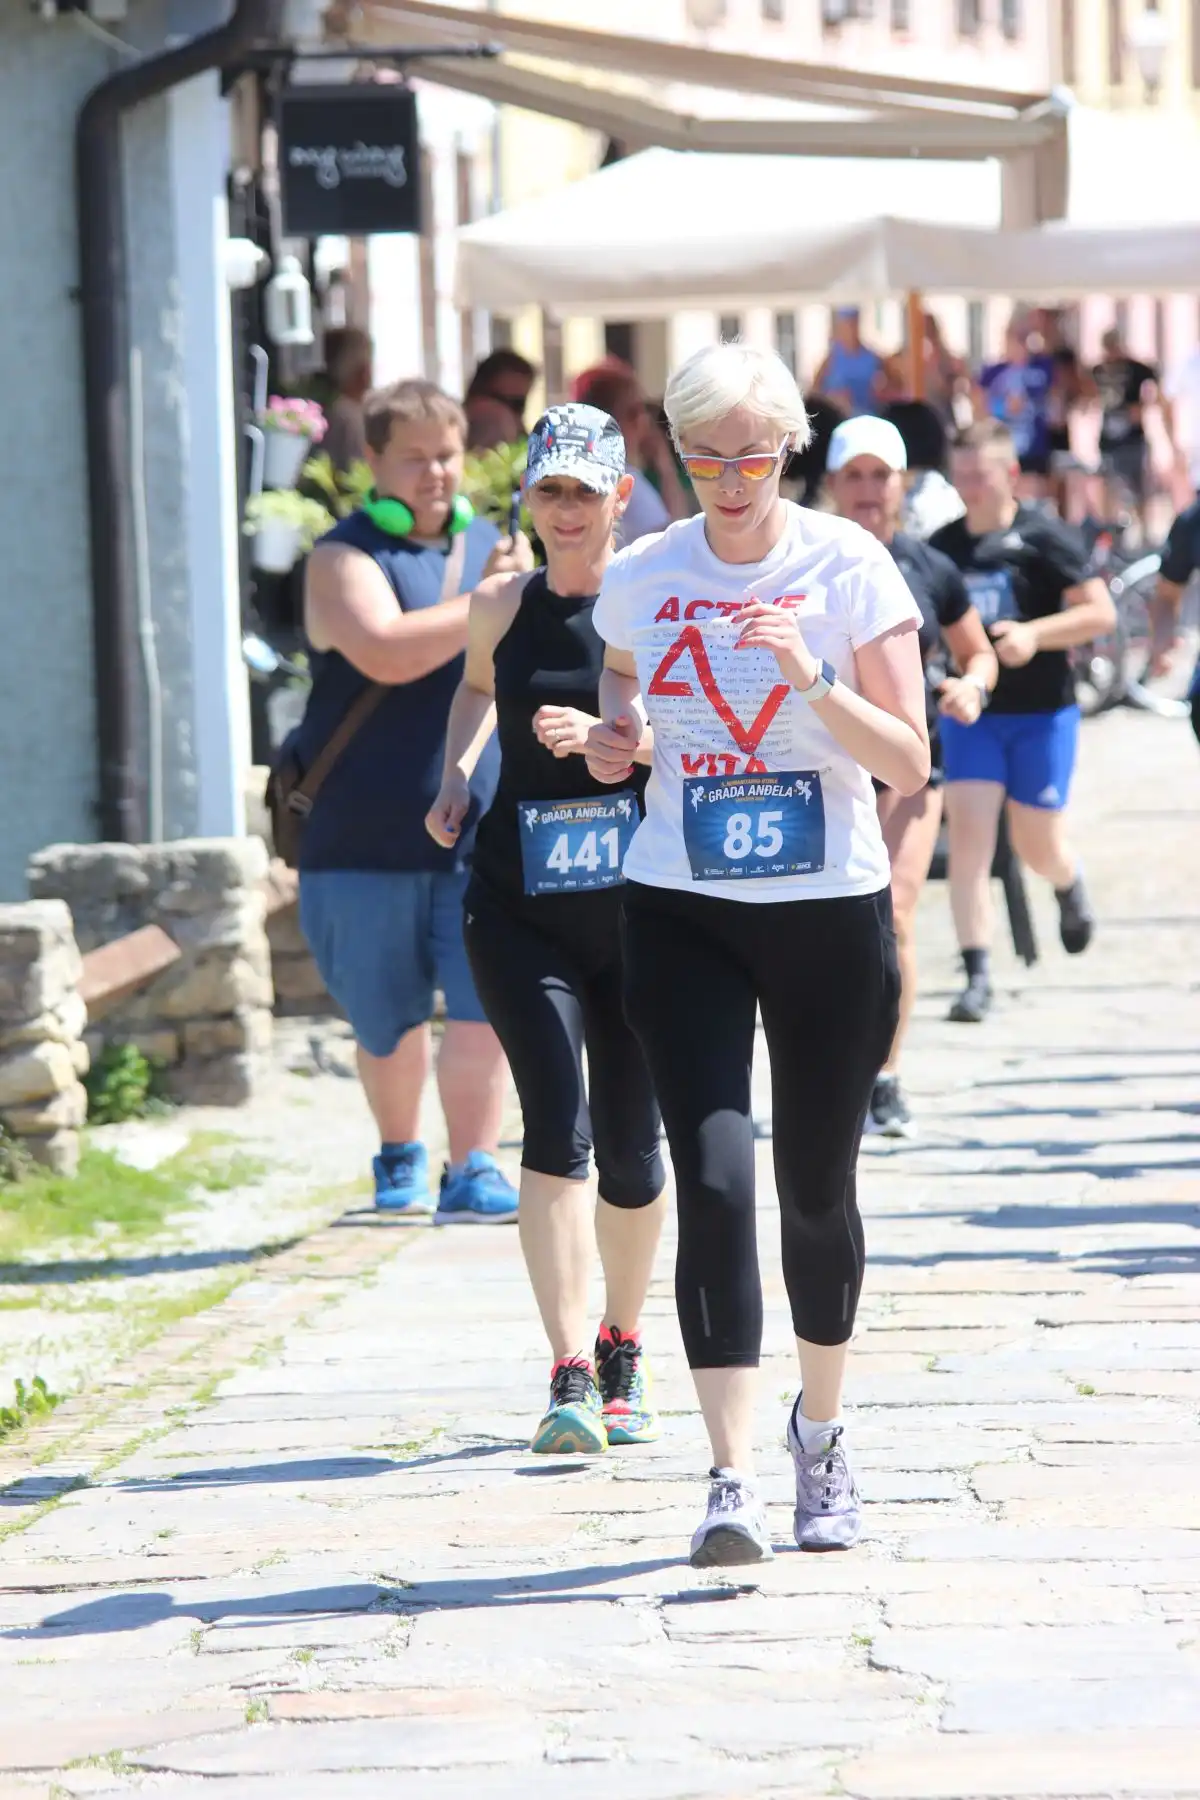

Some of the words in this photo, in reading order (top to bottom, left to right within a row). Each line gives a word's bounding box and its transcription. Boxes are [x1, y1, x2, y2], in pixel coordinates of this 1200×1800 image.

[681, 753, 768, 776] VITA
[708, 784, 745, 803] GRADA
[747, 784, 793, 798] ANĐELA
[541, 808, 574, 825] GRADA
[723, 811, 784, 860] 85
[546, 827, 619, 874] 441
